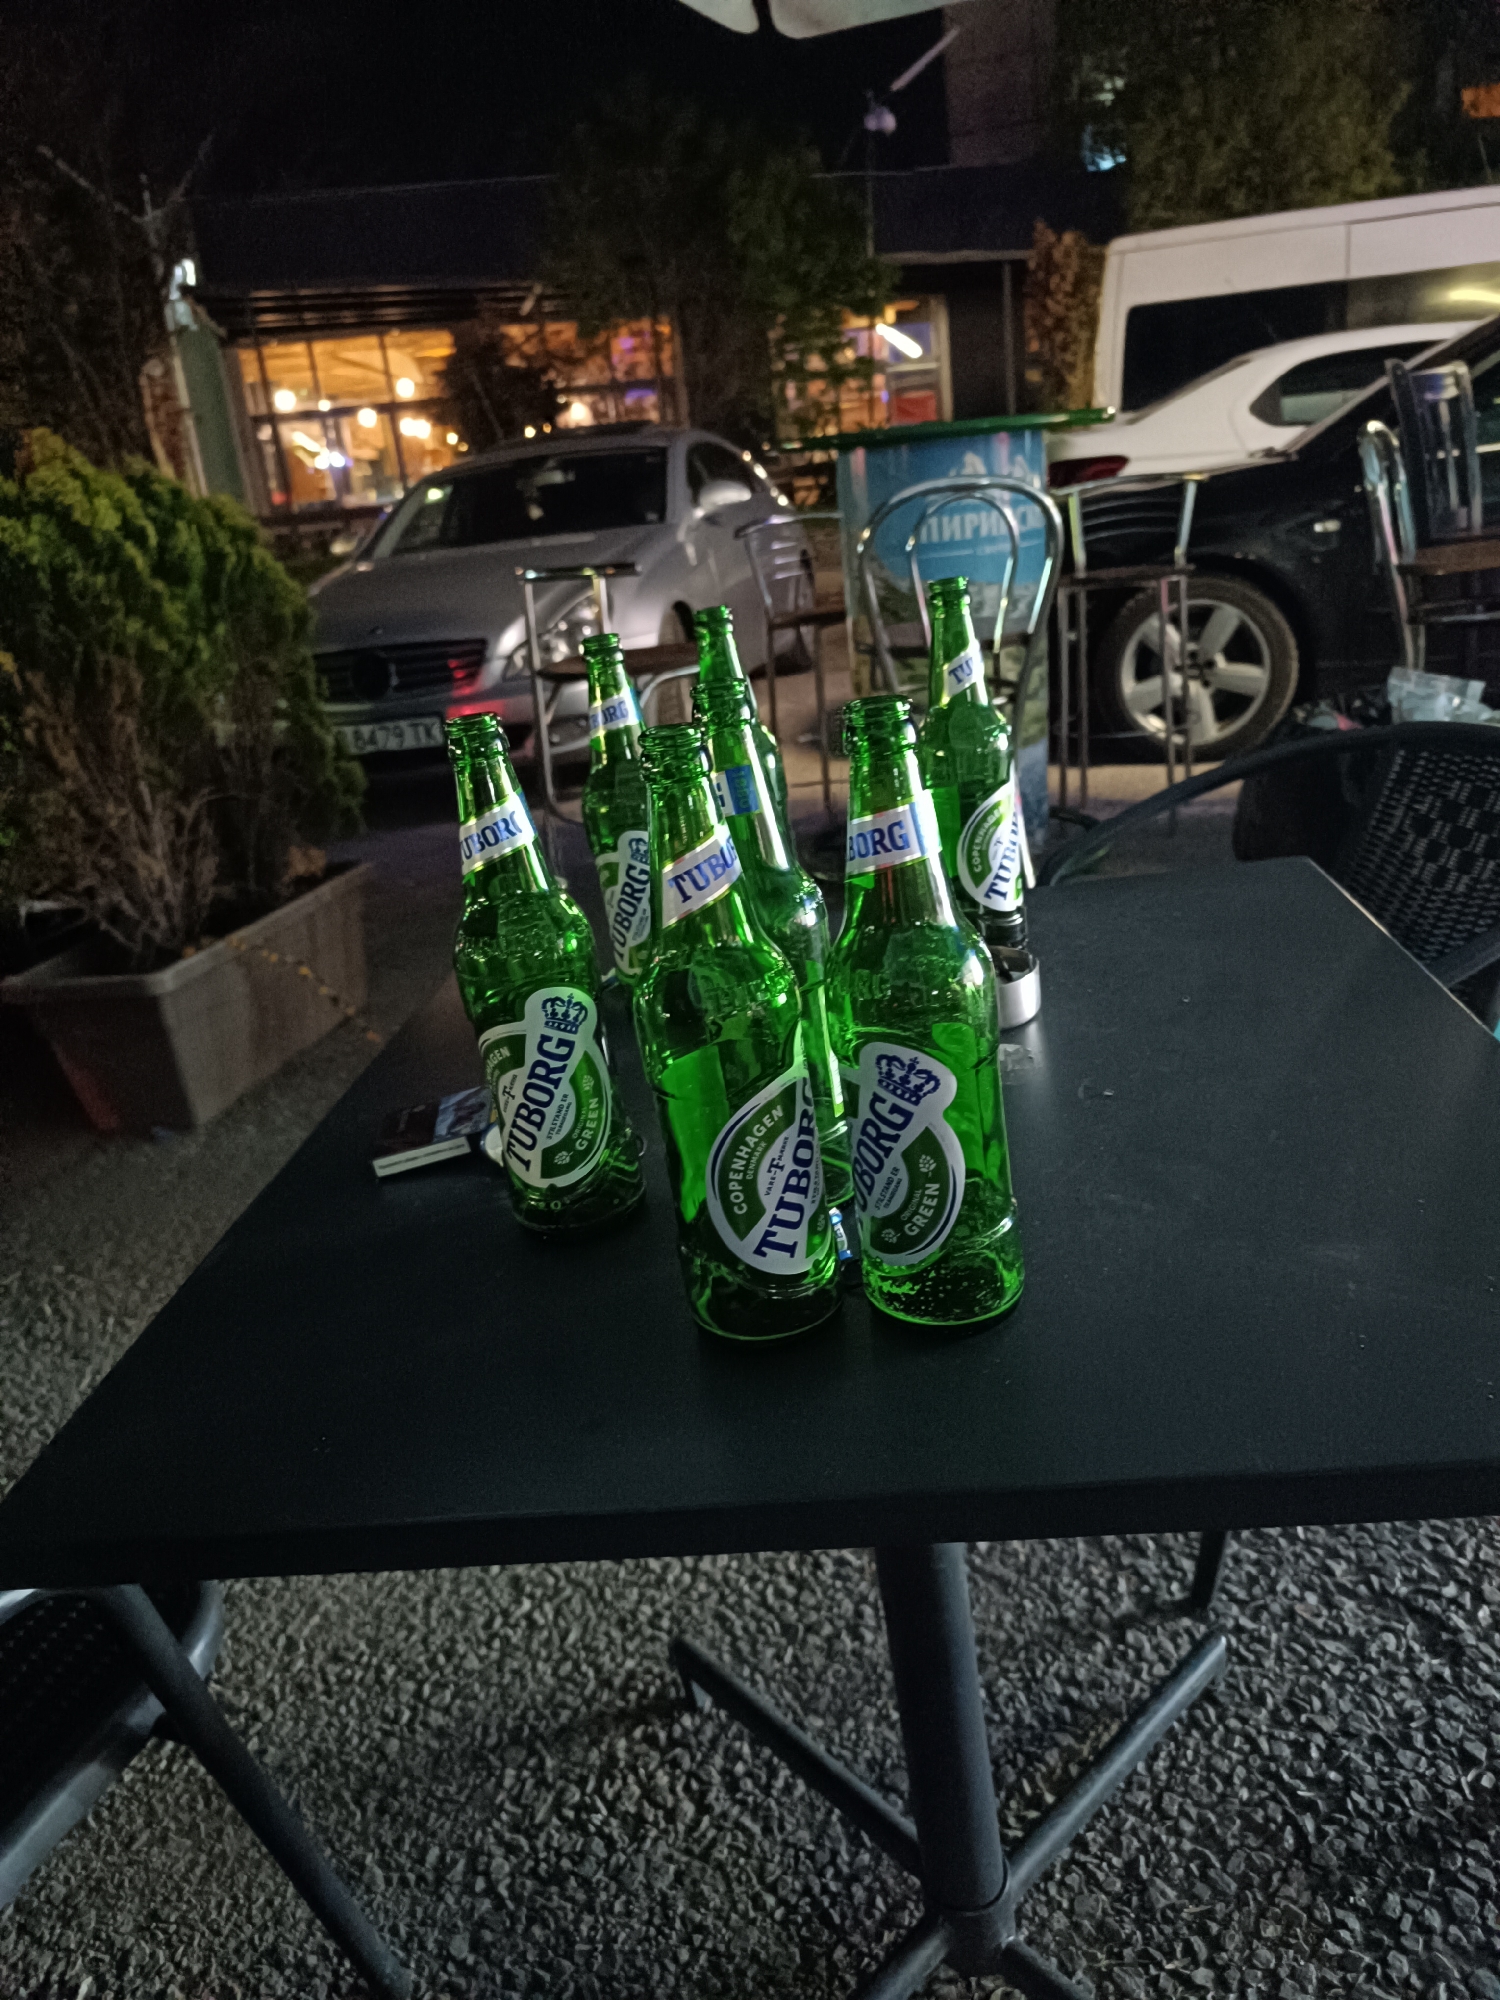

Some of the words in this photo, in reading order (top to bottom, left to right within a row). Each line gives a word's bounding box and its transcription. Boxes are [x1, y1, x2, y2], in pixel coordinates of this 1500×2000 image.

[848, 820, 911, 862] BORG
[506, 1033, 576, 1173] TUBORG
[575, 1097, 599, 1151] GREEN
[728, 1104, 784, 1215] COPENHAGEN
[745, 1140, 768, 1180] DENMARK
[852, 1091, 915, 1213] UBORG
[900, 1189, 922, 1221] ORIGINAL
[903, 1183, 940, 1236] GREEN
